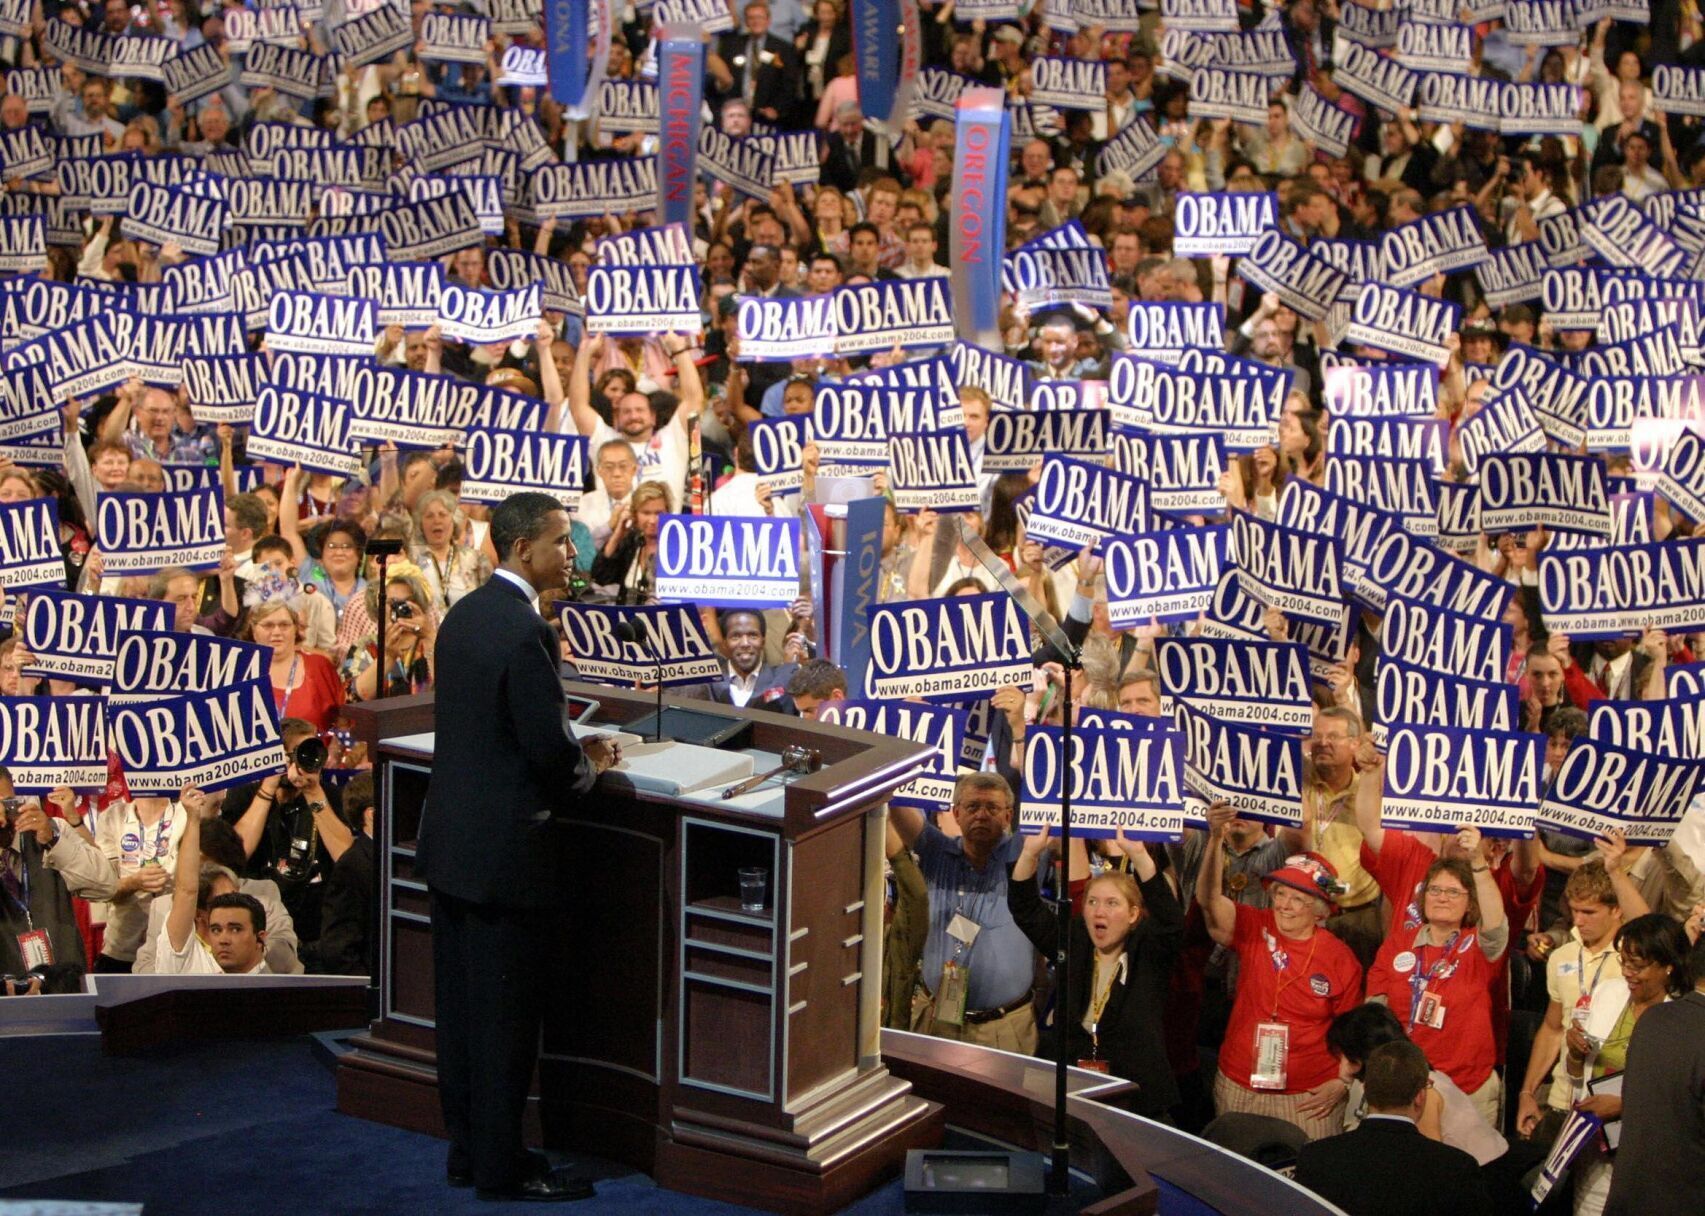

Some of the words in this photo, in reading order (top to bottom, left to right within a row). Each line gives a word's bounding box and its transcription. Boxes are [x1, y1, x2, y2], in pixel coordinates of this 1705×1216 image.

[225, 7, 301, 39] OBAMA
[335, 5, 402, 57] OBAMA
[421, 13, 488, 48] OBAMA
[1400, 22, 1472, 59] OBAMA
[165, 44, 225, 92] OBAMA
[246, 42, 320, 85] OBAMA
[503, 46, 547, 74] OBA
[1032, 57, 1107, 94] OBAMA
[1344, 42, 1419, 105] OBAMA
[601, 83, 659, 118] OBAM
[1192, 68, 1269, 109] OBAMA
[1421, 72, 1500, 115] OBAMA
[1501, 84, 1580, 118] OBAMA
[666, 54, 694, 202] MICHIGAN
[274, 149, 361, 185] OBAMA
[129, 182, 222, 238] OBAMA
[231, 180, 312, 218] OBAMA
[409, 178, 501, 214] OBMA
[958, 125, 990, 263] OREGON
[1176, 195, 1275, 237] OBAMA
[381, 193, 478, 247] OBAMA
[1383, 208, 1484, 271] OBAMA
[1597, 196, 1683, 279] OBAMA
[288, 234, 386, 282] BAMA
[598, 227, 694, 266] OBAMA
[1015, 250, 1110, 291] OBAMA
[1252, 230, 1344, 310] OBAMA
[347, 265, 441, 309] OBAMA
[440, 284, 543, 327] OBAMA
[588, 268, 700, 314] OBAMA
[836, 280, 951, 334] OBAMA
[1543, 269, 1601, 312] OBA
[188, 315, 246, 356] AMA
[269, 292, 375, 342] OBAMA
[738, 297, 838, 341] OBAMA
[1128, 305, 1224, 348] OBAMA
[1356, 283, 1454, 343] OBAMA
[1548, 317, 1600, 326] www.obama
[839, 330, 954, 349] www.obama2004.com
[272, 353, 358, 401] OBAM
[351, 368, 449, 426] OBAMA
[1153, 372, 1270, 427] OBAMA
[1328, 369, 1436, 416] OBAMA
[254, 388, 362, 454] OBAMA
[814, 387, 936, 440] OBAMA
[987, 412, 1107, 454] OBAMA
[1459, 388, 1540, 474] OBAMA
[249, 442, 360, 472] www.obama2004.com
[466, 431, 584, 487] OBAMA
[752, 415, 814, 473] OBA
[890, 436, 975, 489] OBAMA
[1114, 433, 1222, 489] OBAMA
[1328, 419, 1446, 472] OBAMA
[1038, 459, 1146, 534] OBAMA
[1152, 495, 1225, 506] ma2004.com
[1325, 457, 1435, 514] OBAMA
[1480, 457, 1610, 512] OBAMA
[98, 491, 225, 550] OBAMA
[1484, 512, 1610, 530] www.obama2004.com
[658, 519, 799, 578] OBAMA
[1233, 514, 1342, 598] OBAMA
[657, 583, 798, 597] www.obama2004.com
[852, 531, 878, 647] IOWA
[1239, 573, 1341, 620] www.obama2004.com
[1372, 533, 1506, 621] OBAMA
[1539, 555, 1616, 612] OBA
[1609, 543, 1705, 610] OBAM
[561, 606, 719, 663] OBAMA
[871, 597, 1031, 675] OBAMA
[1382, 600, 1502, 684] OBAMA
[1620, 608, 1705, 627] www.obama200
[116, 635, 260, 693] OBAMA
[578, 662, 720, 682] www.obama2004.com
[878, 669, 1032, 696] www.obama2004.com
[1159, 641, 1312, 701] OBAMA
[1378, 663, 1510, 731] OBAMA
[114, 684, 280, 770] OBAMA
[1175, 704, 1301, 799] OBAMA
[1589, 700, 1705, 760] OBAM
[128, 752, 284, 788] www.obama2004.com
[1025, 732, 1182, 805] OBAMA
[1387, 729, 1539, 804] OBAMA
[1555, 743, 1701, 819] OBAMA
[1021, 808, 1182, 829] www.bama2004.com
[1383, 804, 1536, 828] www.obama2004.com
[1540, 805, 1674, 838] www.obama2004.com
